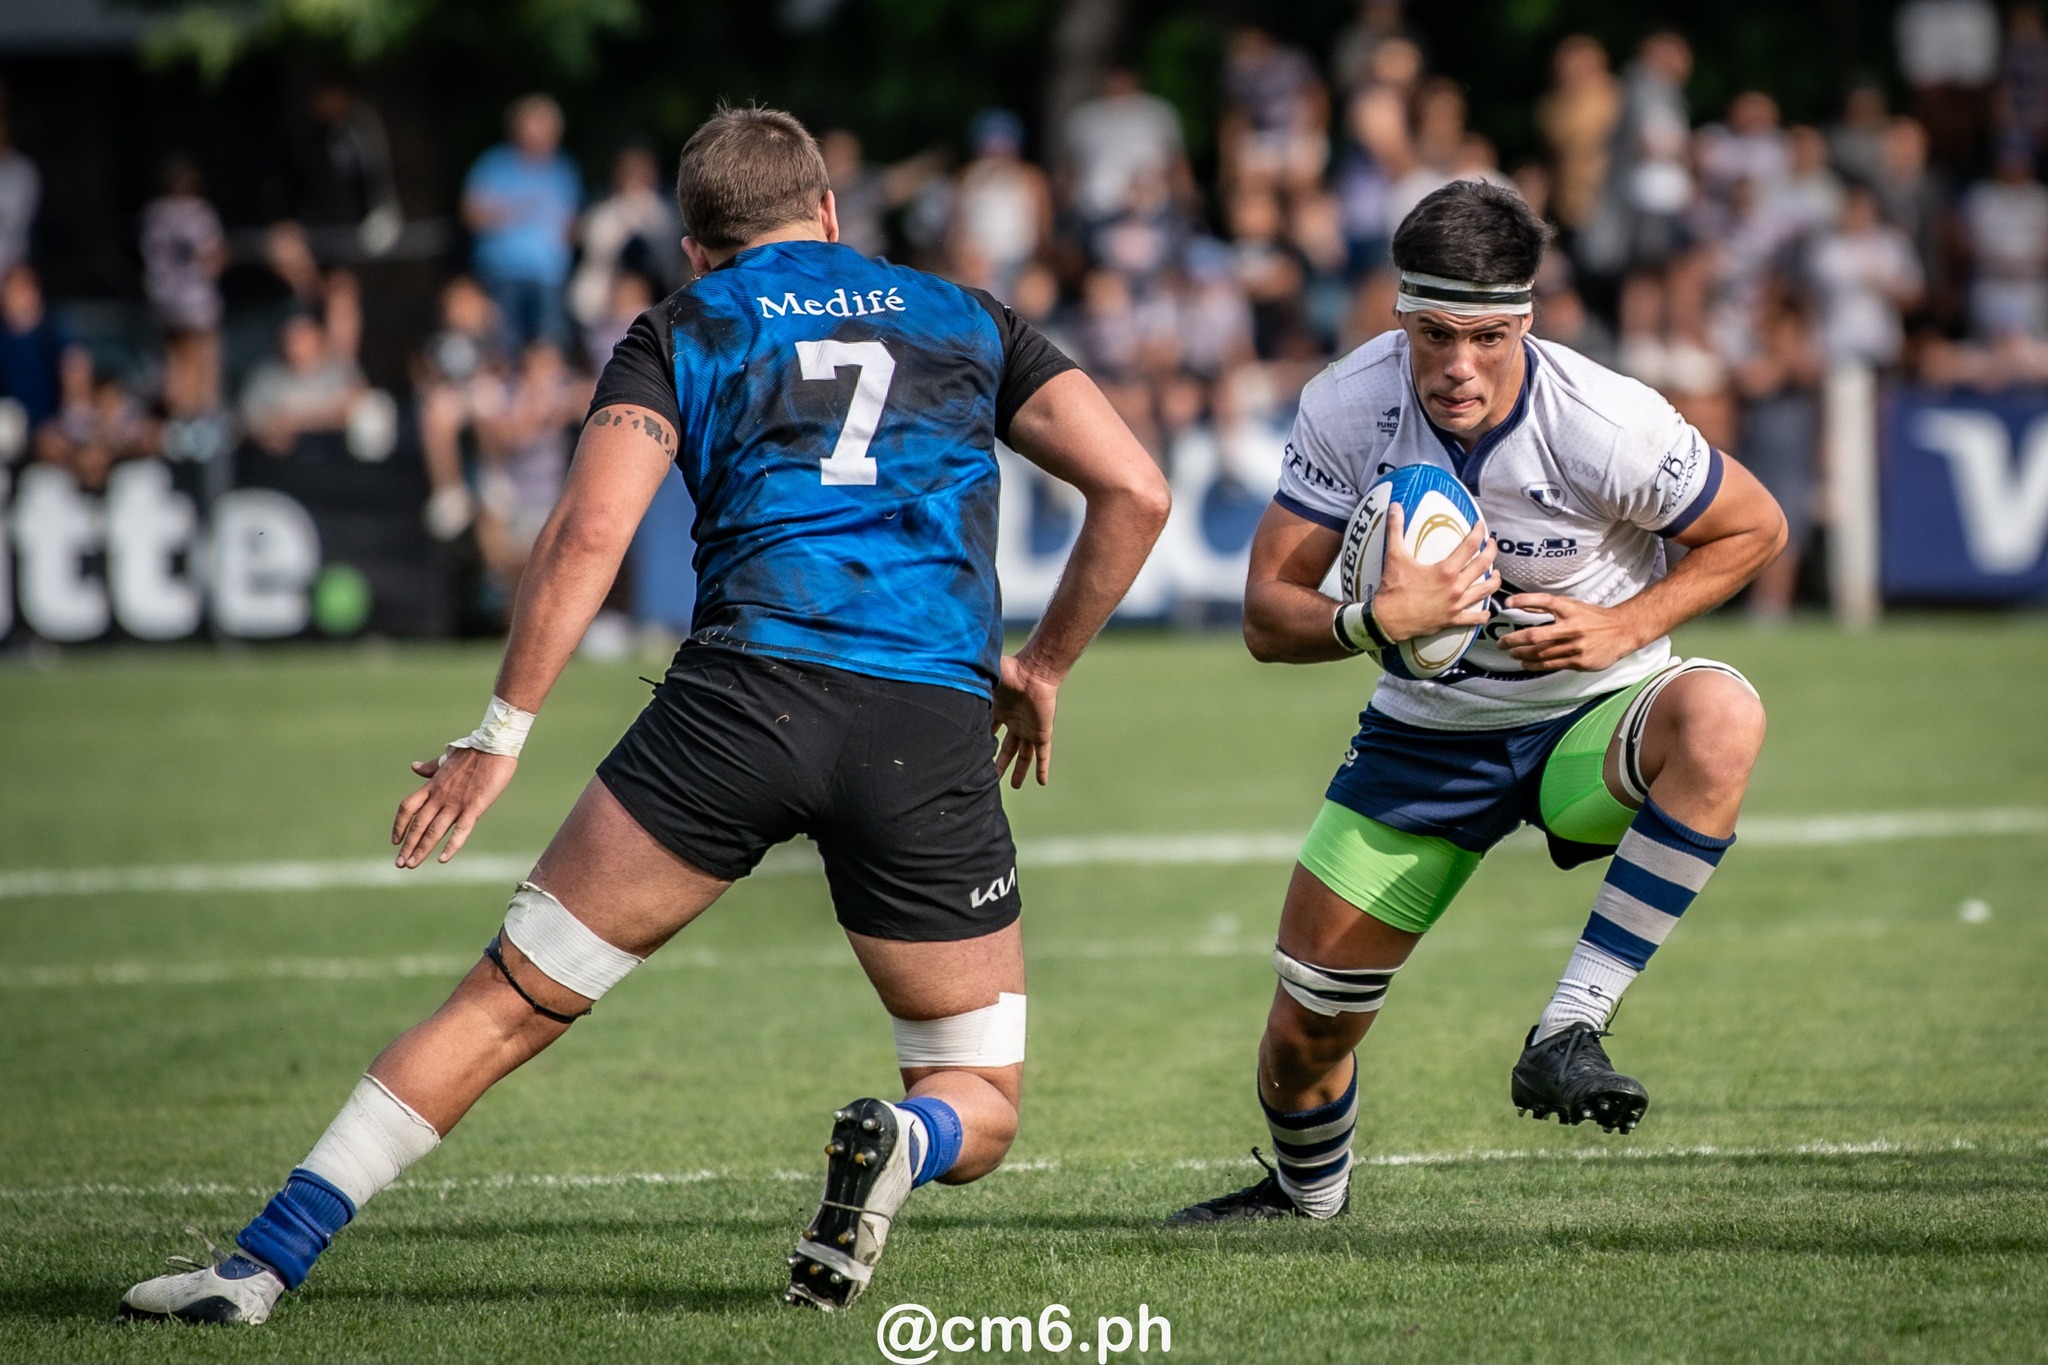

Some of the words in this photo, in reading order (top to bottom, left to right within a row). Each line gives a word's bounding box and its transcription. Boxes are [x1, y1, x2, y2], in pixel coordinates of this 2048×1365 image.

[757, 287, 906, 318] Medifé
[795, 339, 896, 486] 7
[970, 866, 1016, 909] KIA
